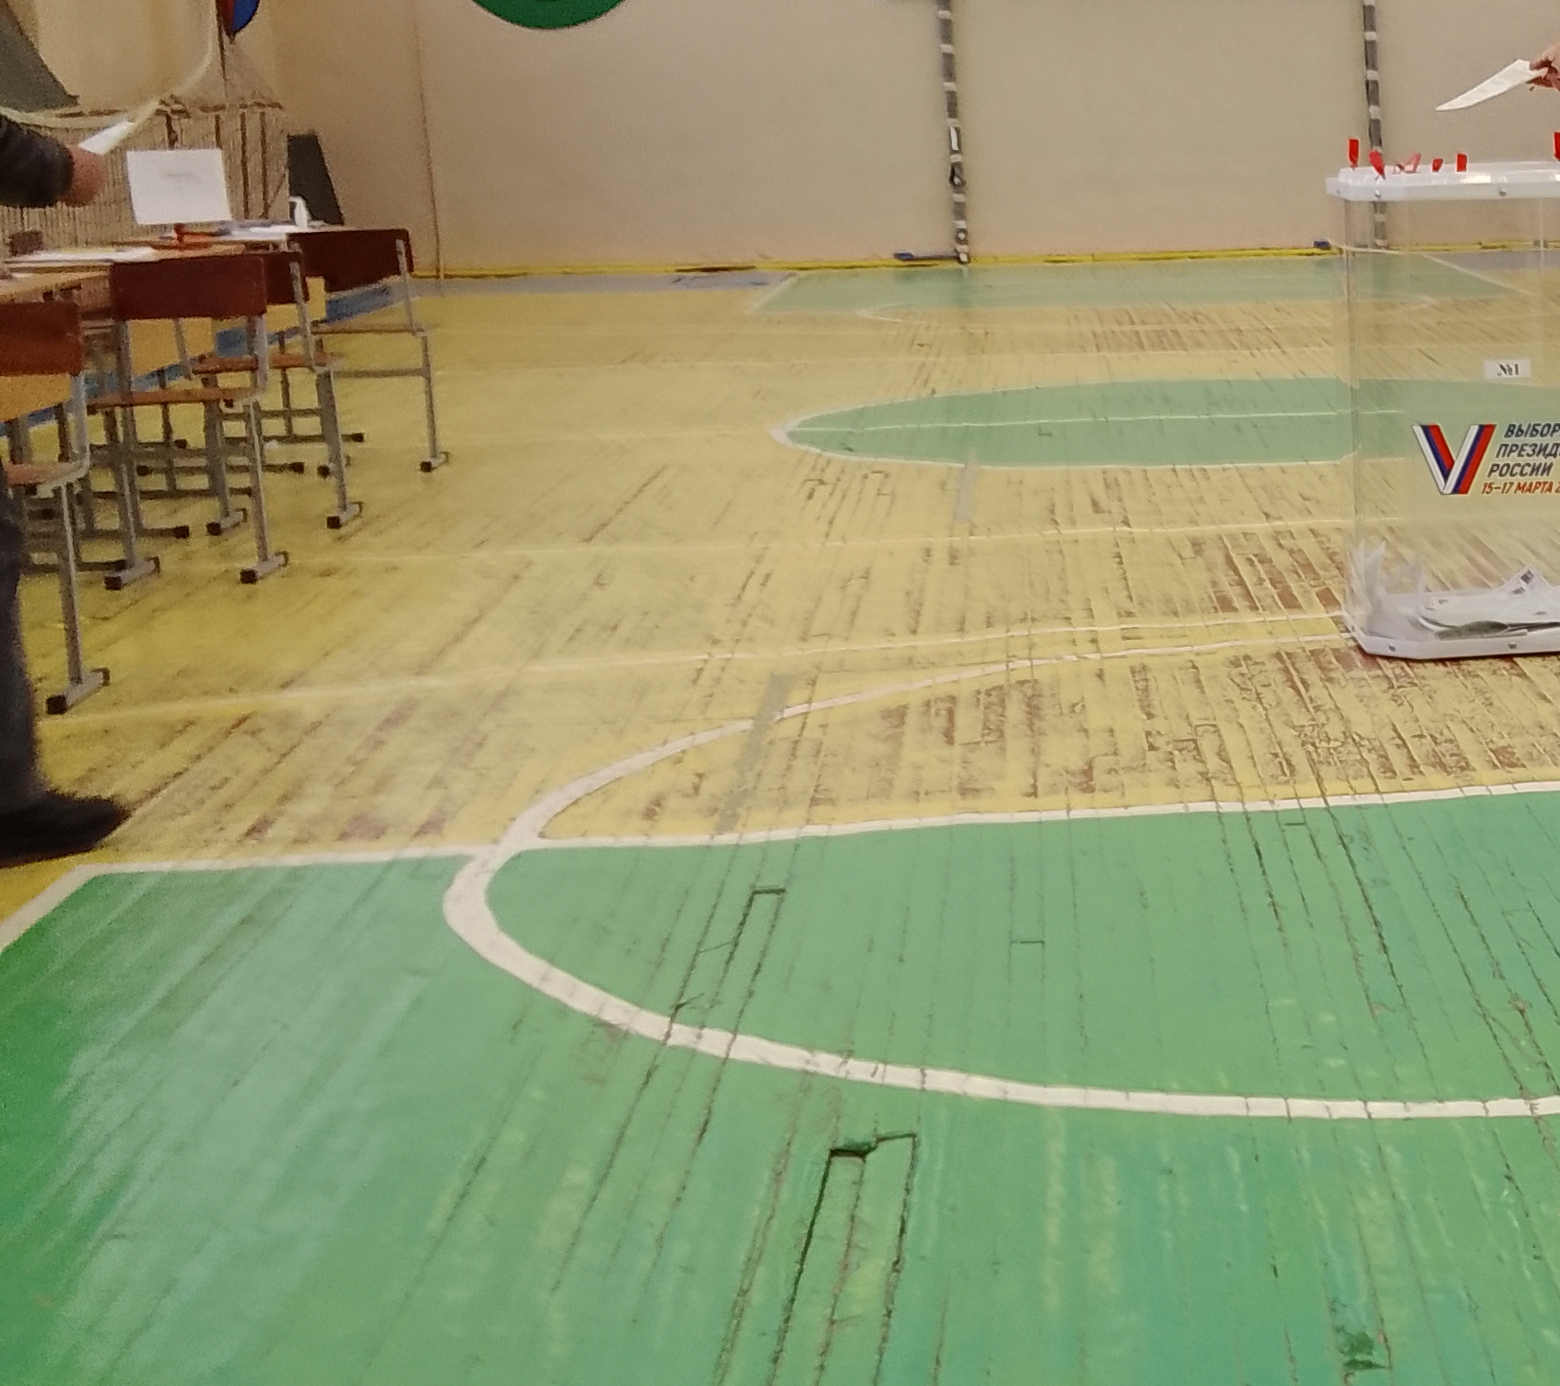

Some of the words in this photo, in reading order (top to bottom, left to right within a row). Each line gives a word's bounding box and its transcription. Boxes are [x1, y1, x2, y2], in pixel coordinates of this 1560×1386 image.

[1497, 363, 1519, 376] №1
[1487, 462, 1554, 477] РОССИИ
[1514, 480, 1553, 494] МАРТА
